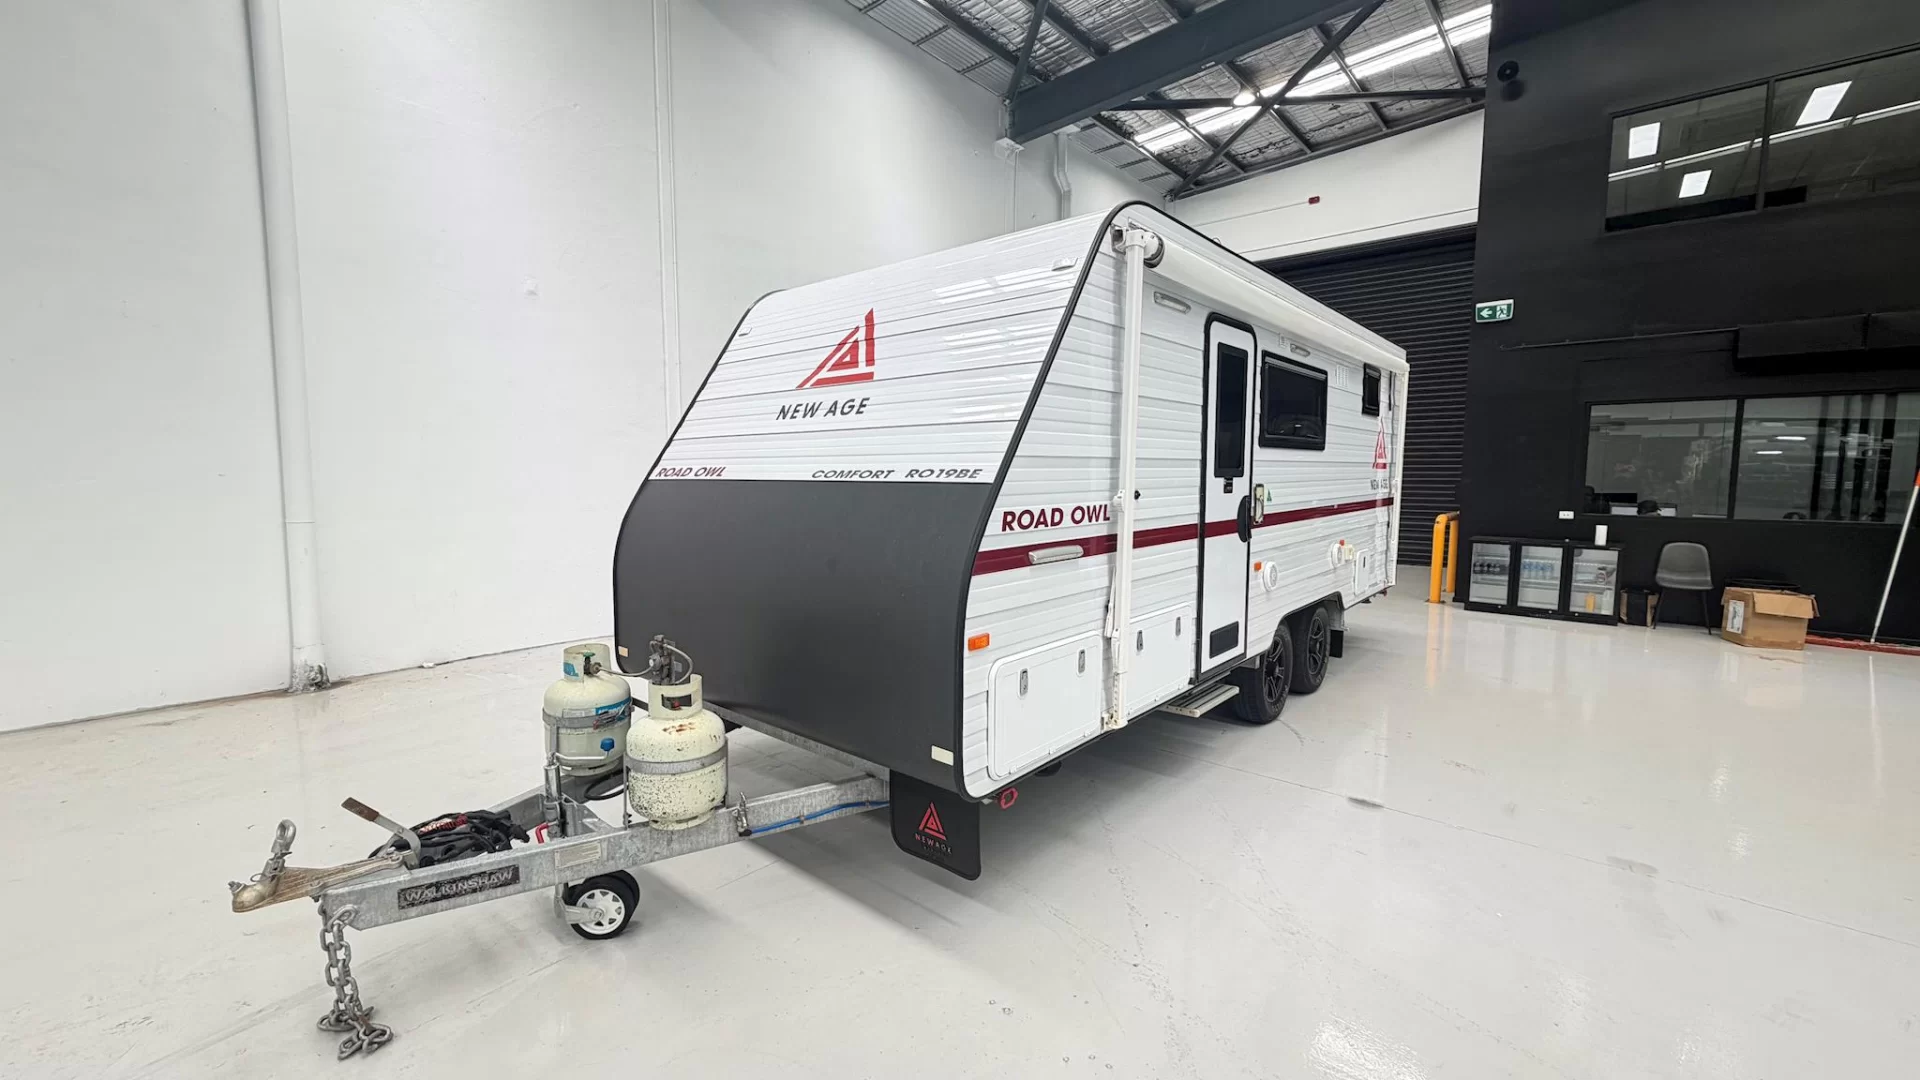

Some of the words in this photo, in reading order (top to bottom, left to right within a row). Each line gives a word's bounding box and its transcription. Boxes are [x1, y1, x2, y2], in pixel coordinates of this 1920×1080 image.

[775, 401, 823, 421] NEW
[823, 397, 870, 418] AGE
[655, 467, 693, 478] ROAD
[694, 466, 727, 478] OWL
[811, 469, 895, 479] COMFORT
[1001, 507, 1064, 532] ROAD
[1070, 503, 1111, 525] OWL
[914, 832, 935, 847] NEW
[935, 841, 953, 855] AGE
[405, 866, 514, 902] WALKINSHAW
